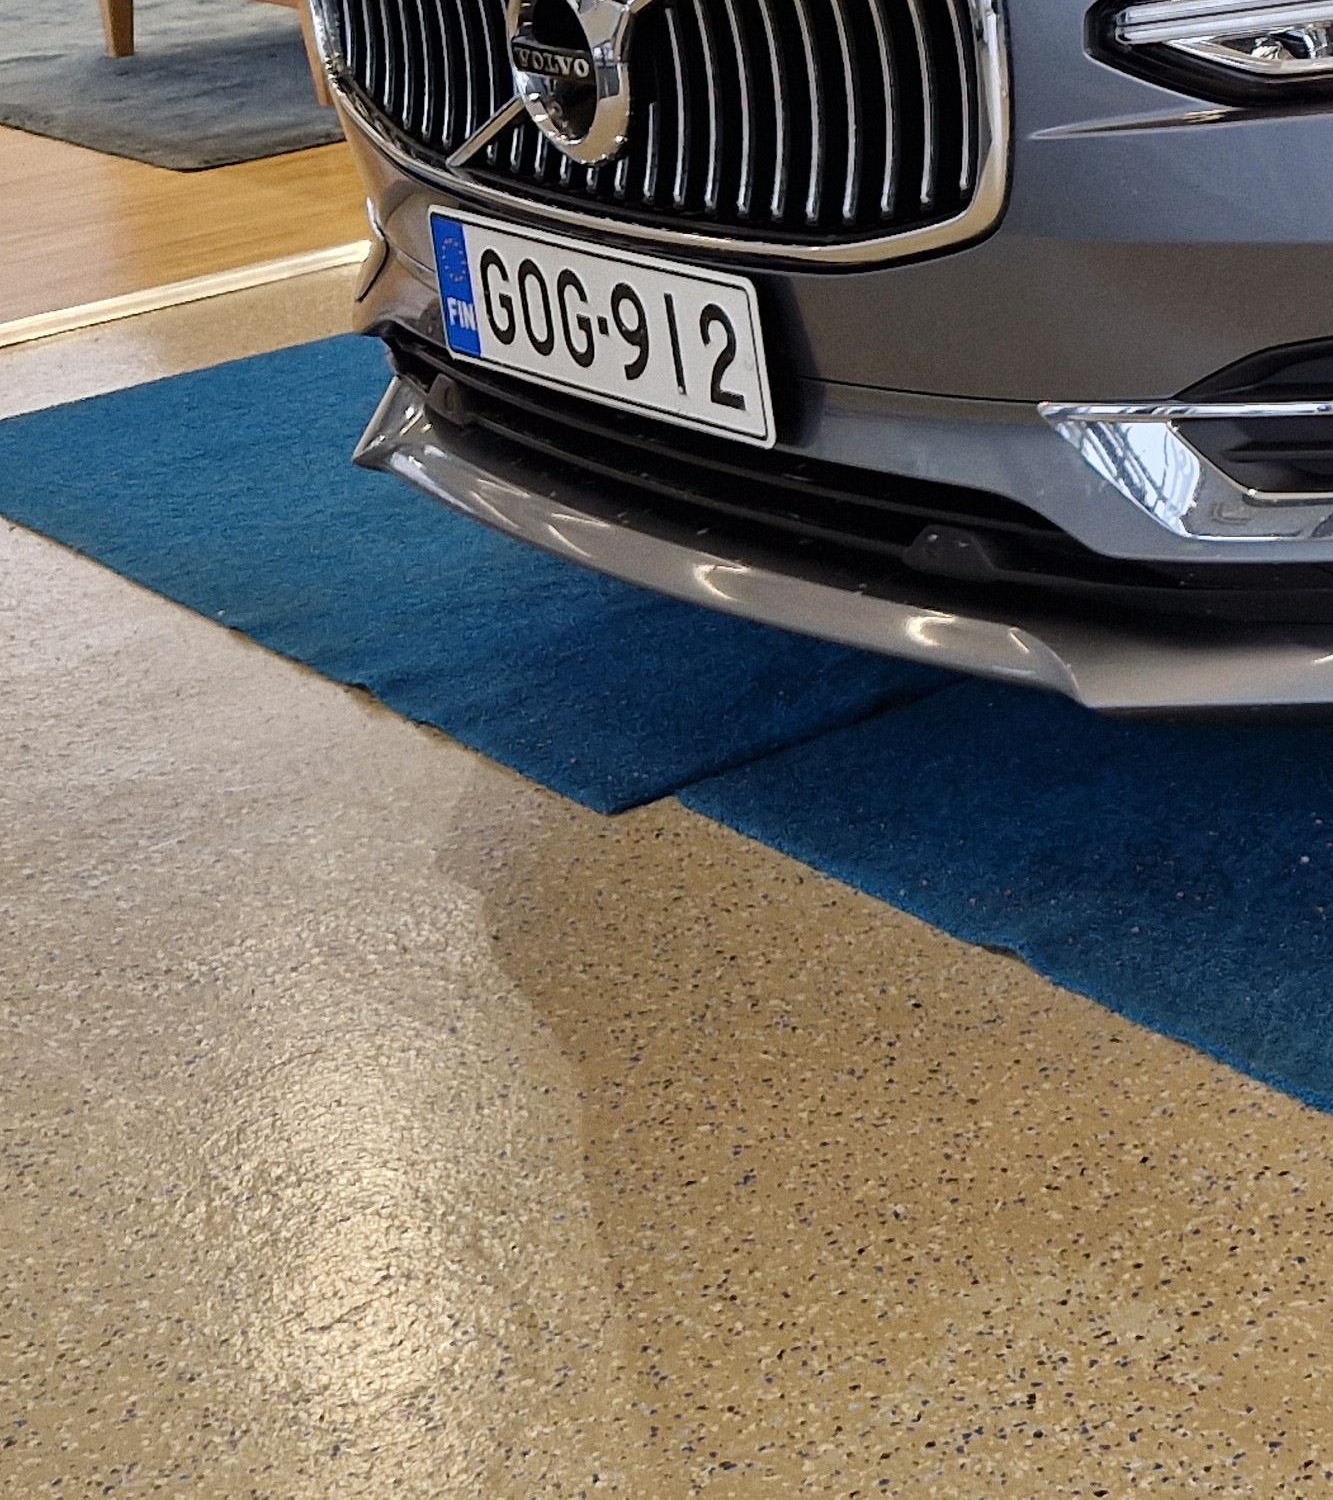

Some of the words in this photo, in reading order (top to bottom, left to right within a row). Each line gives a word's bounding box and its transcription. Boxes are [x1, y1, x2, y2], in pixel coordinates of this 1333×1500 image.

[514, 48, 590, 78] VOLVO
[446, 296, 477, 331] FIN
[480, 248, 746, 411] GOG-912
